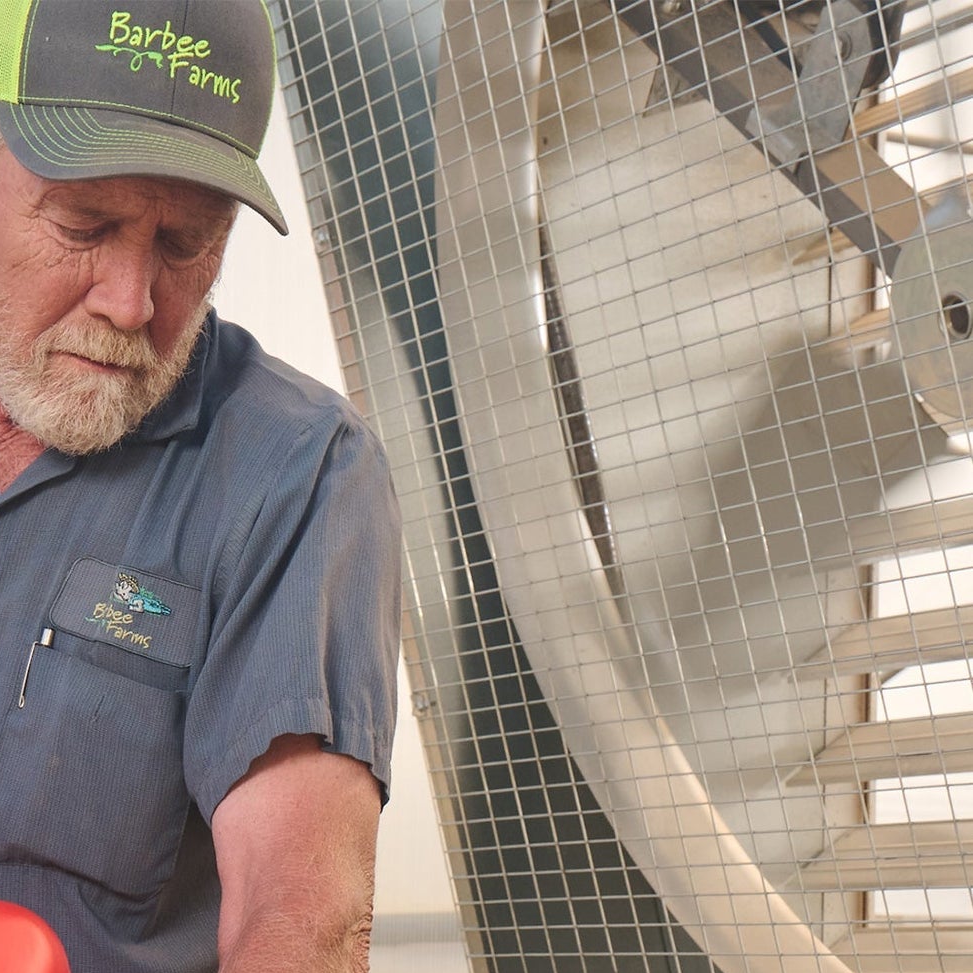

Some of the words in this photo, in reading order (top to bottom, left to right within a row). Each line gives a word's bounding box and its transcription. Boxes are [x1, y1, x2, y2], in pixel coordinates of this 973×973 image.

[109, 11, 211, 58] Barbee
[167, 51, 241, 104] Farms
[107, 620, 152, 649] Farms
